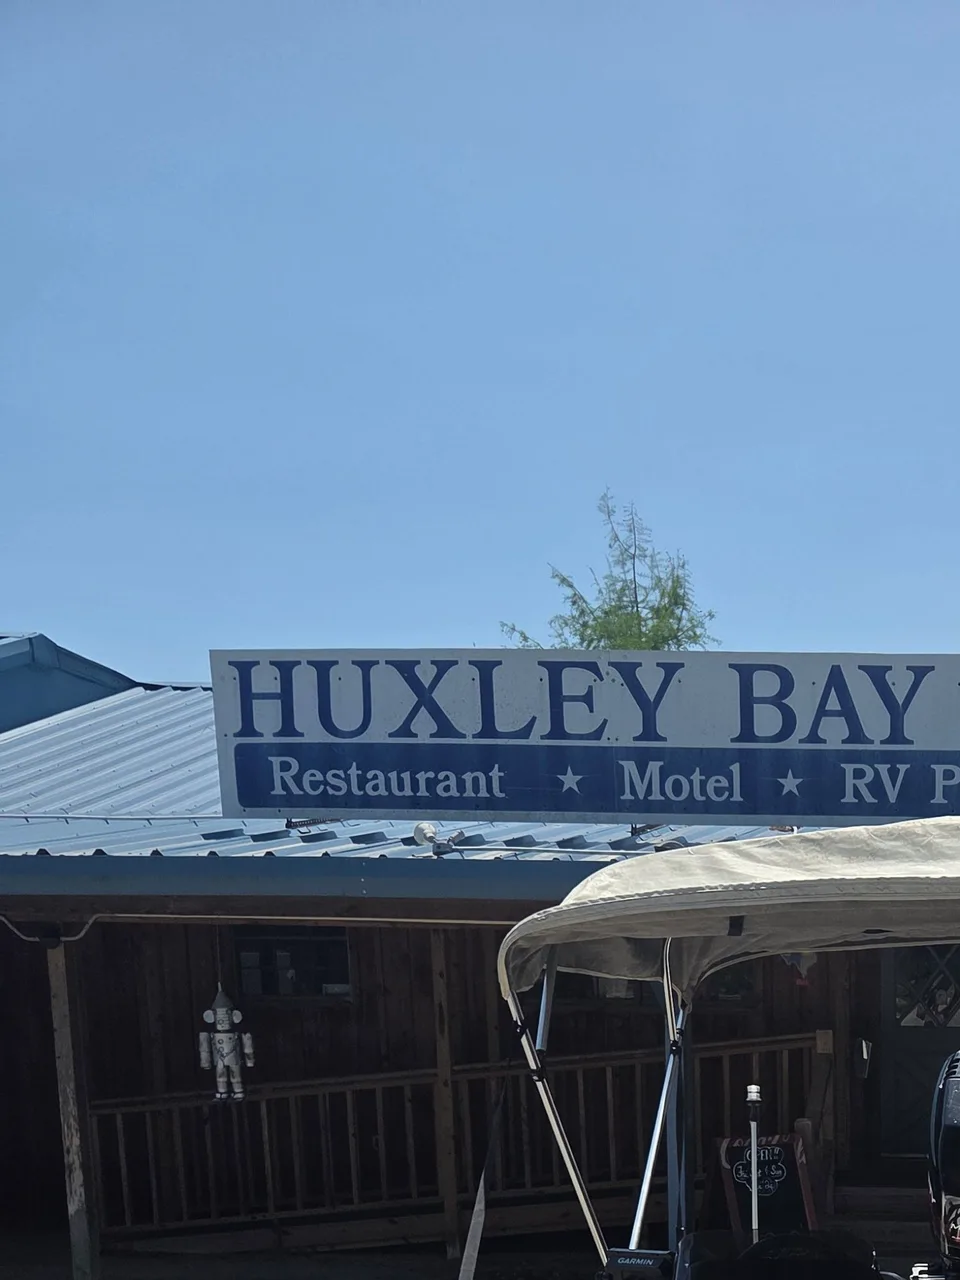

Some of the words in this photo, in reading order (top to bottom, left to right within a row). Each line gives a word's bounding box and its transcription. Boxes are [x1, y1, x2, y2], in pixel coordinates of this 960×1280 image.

[228, 660, 685, 742] HUXLEY
[728, 664, 935, 746] BAY
[268, 757, 506, 797] Restaurant
[618, 761, 744, 802] Motel
[841, 764, 911, 803] RV
[617, 1257, 654, 1266] GARMIN
